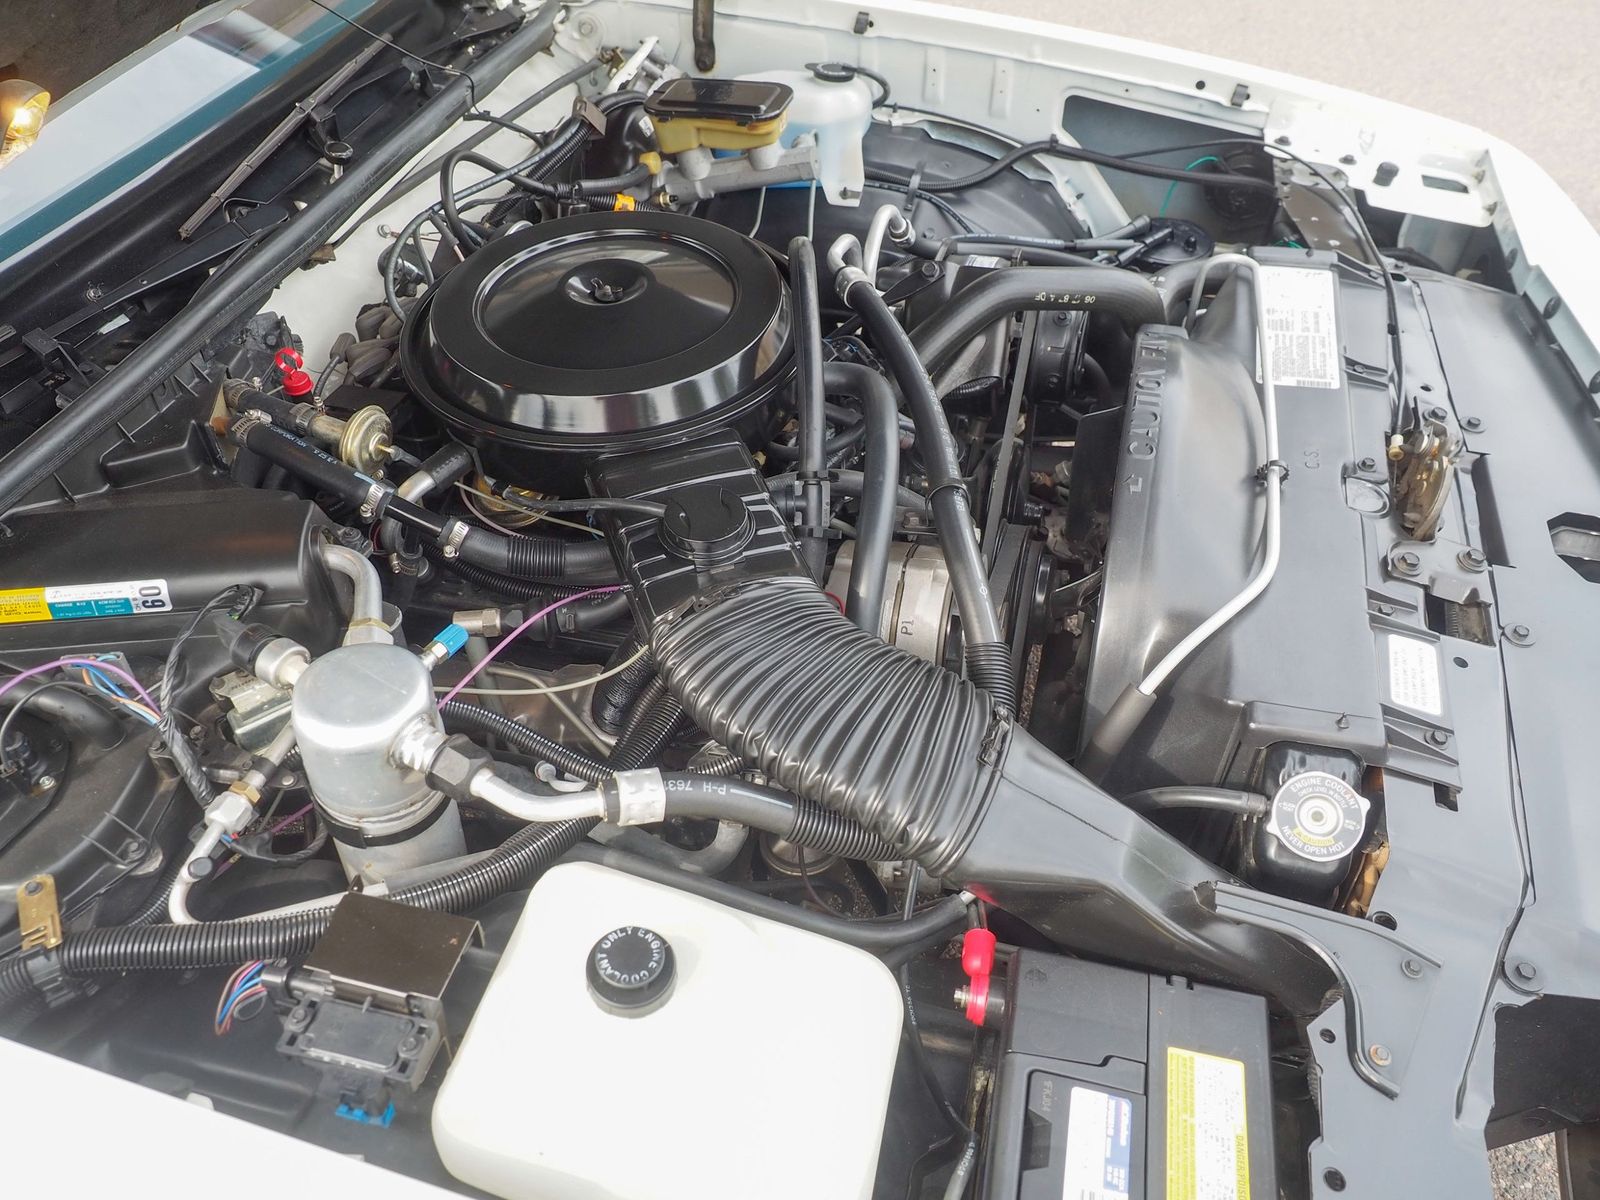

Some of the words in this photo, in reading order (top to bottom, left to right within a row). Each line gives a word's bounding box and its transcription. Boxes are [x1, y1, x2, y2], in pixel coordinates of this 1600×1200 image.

[1128, 368, 1165, 459] CAUTION
[703, 781, 727, 795] P-H
[1290, 777, 1322, 793] ENGINE
[1325, 779, 1358, 808] COOLANT
[1281, 825, 1303, 849] NEVER
[1304, 844, 1327, 855] OPEN
[1329, 841, 1345, 853] HOT
[601, 926, 633, 949] ONLY
[637, 928, 661, 969] ENGINE
[596, 952, 650, 984] COOLANT
